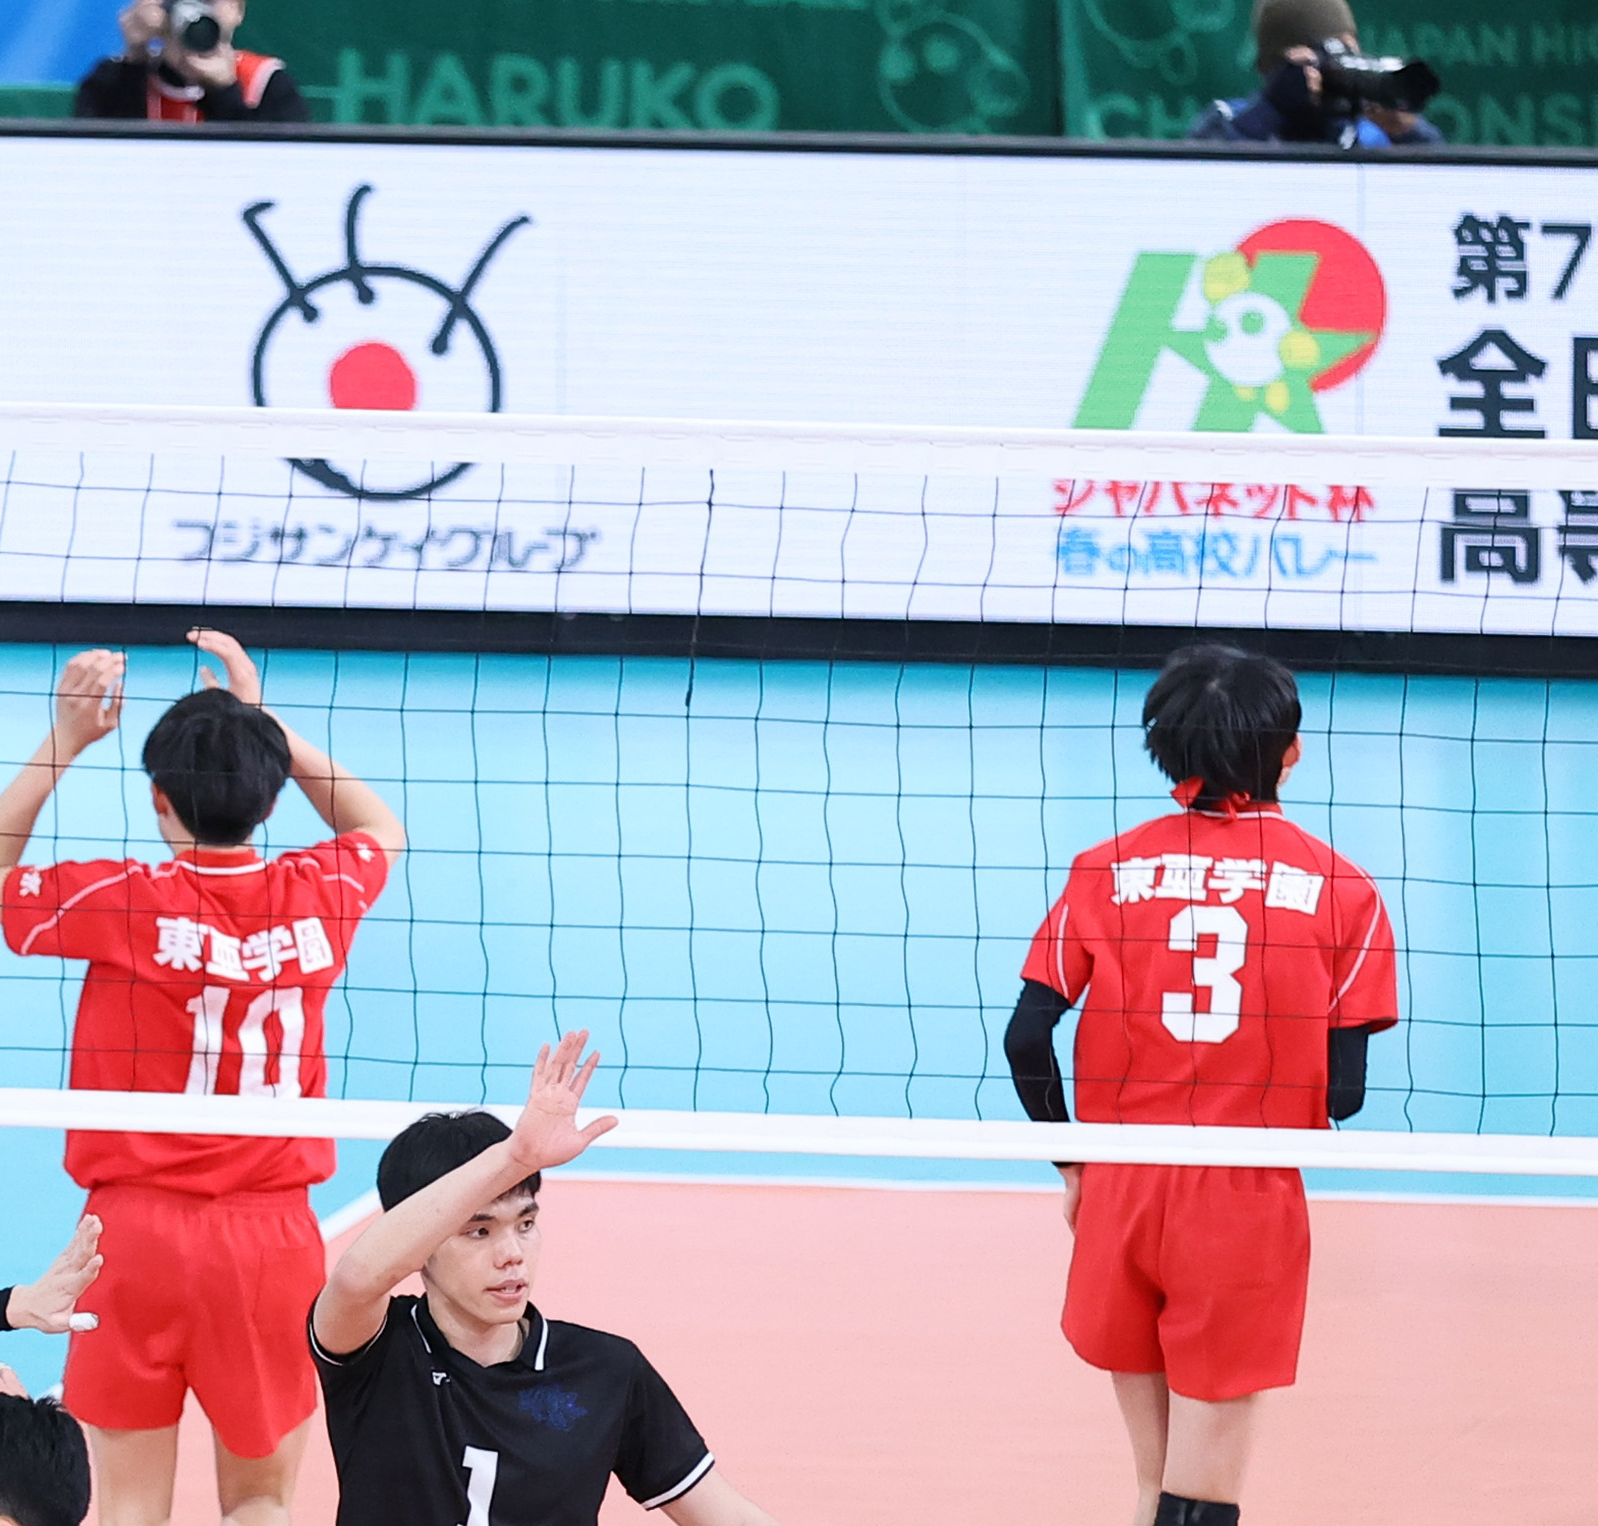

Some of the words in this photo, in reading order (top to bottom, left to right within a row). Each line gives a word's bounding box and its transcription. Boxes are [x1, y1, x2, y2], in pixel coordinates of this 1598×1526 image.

[335, 47, 781, 131] HARUKO
[172, 517, 601, 571] フジサンケイグループ
[1054, 526, 1378, 580] 春の高校バレー
[1110, 853, 1325, 916] 東亜学園
[153, 916, 334, 983] 東亜学園
[1161, 904, 1248, 1044] 3
[183, 985, 305, 1098] 10
